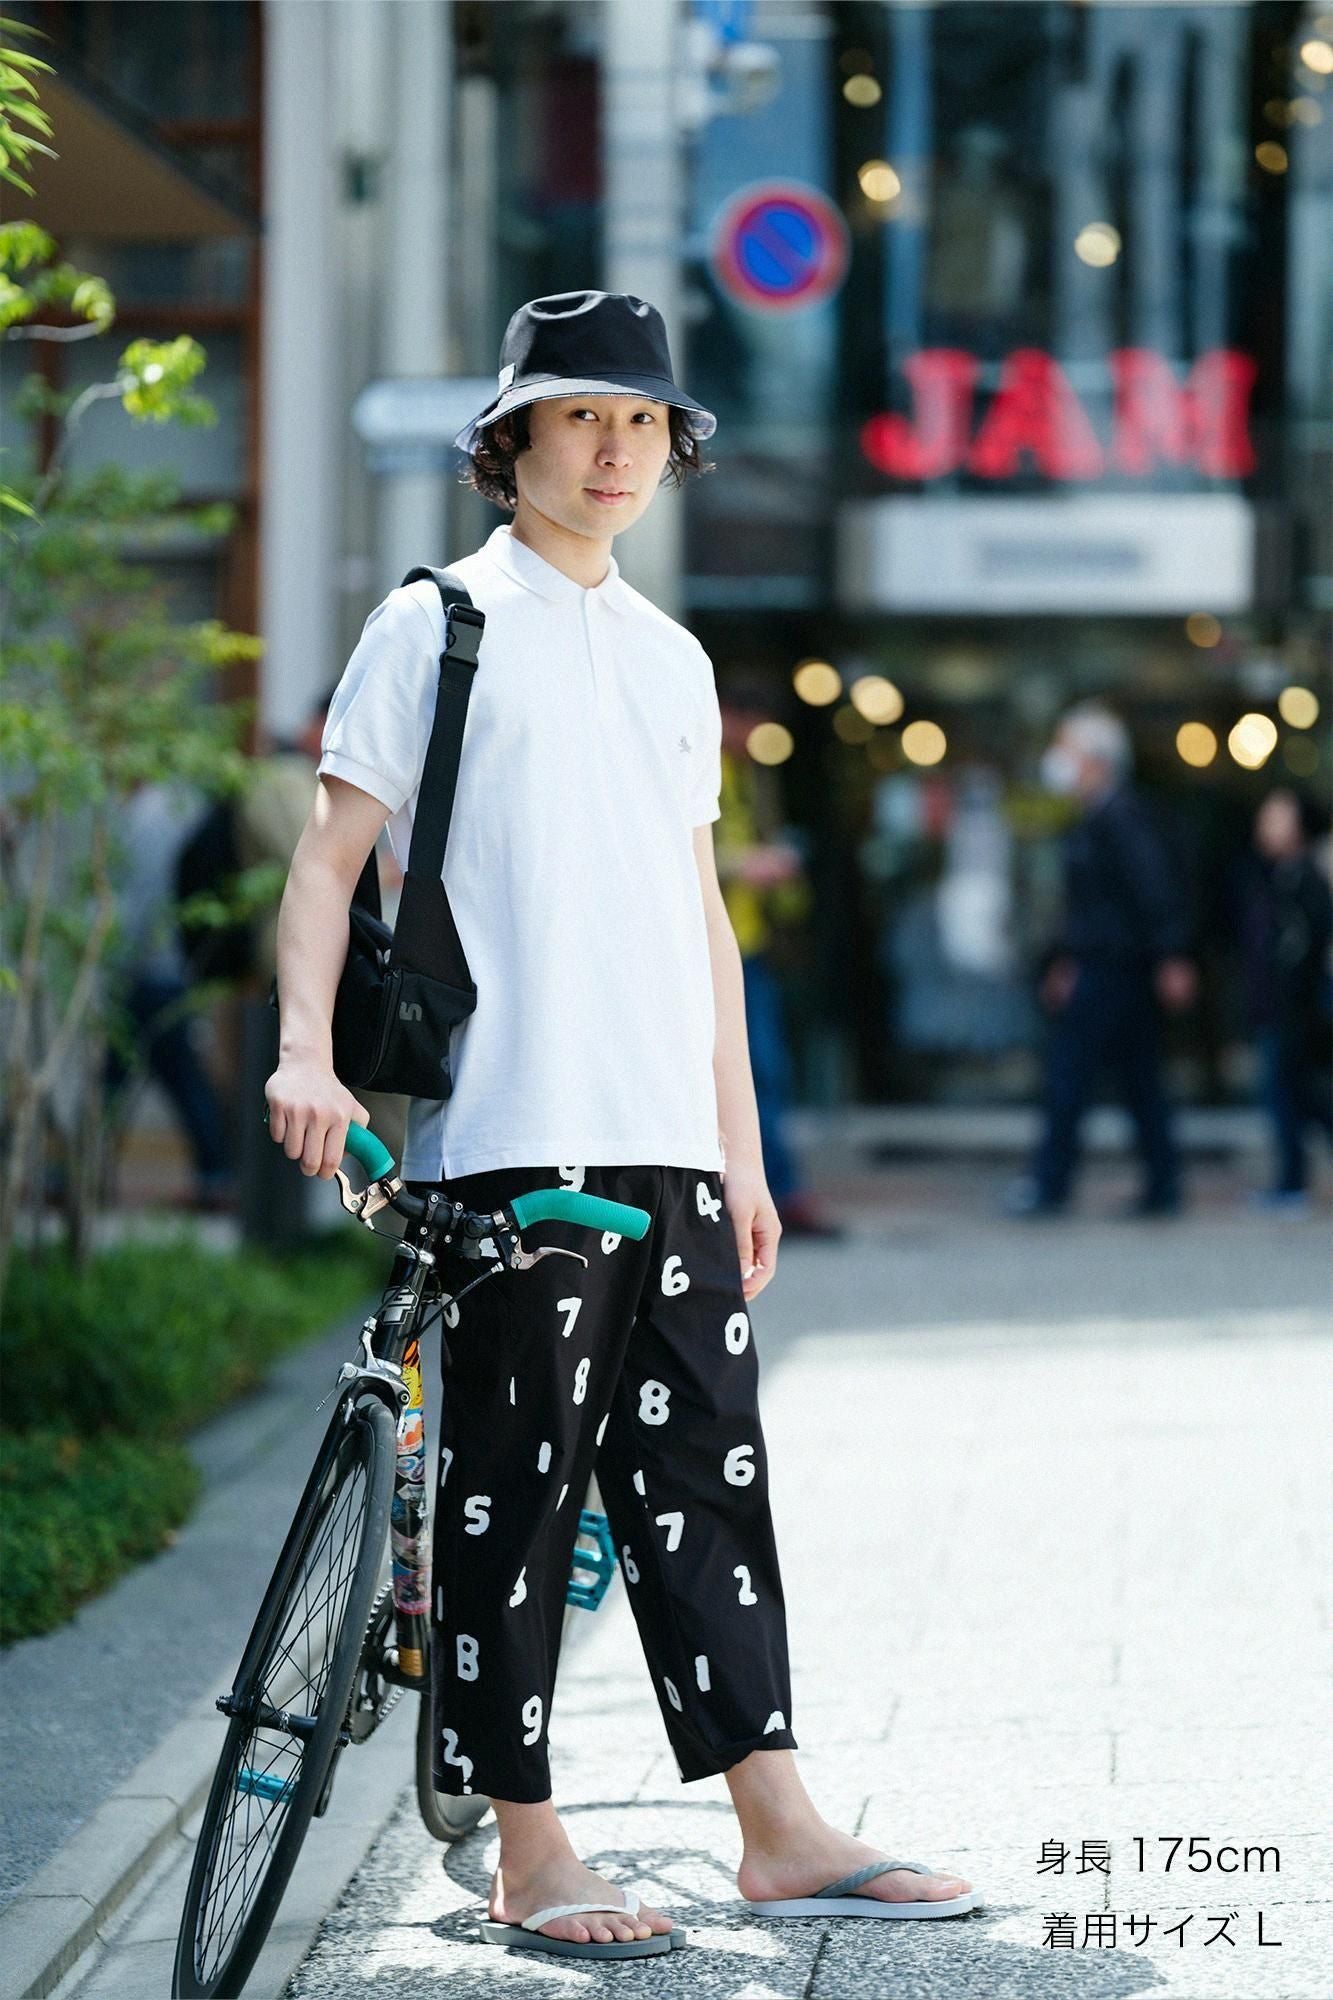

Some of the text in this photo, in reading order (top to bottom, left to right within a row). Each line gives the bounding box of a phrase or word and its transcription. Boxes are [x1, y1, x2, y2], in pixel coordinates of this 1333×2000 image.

[860, 347, 1258, 482] JAM
[696, 1181, 722, 1223] 4
[661, 1255, 690, 1296] 6
[557, 1297, 582, 1338] 7
[725, 1312, 749, 1355] 0
[573, 1357, 591, 1405] 8
[638, 1379, 671, 1426] 8
[724, 1444, 756, 1487] 6
[464, 1495, 491, 1535] 5
[656, 1511, 684, 1552] 7
[733, 1565, 758, 1605] 2
[521, 1694, 543, 1746] 9
